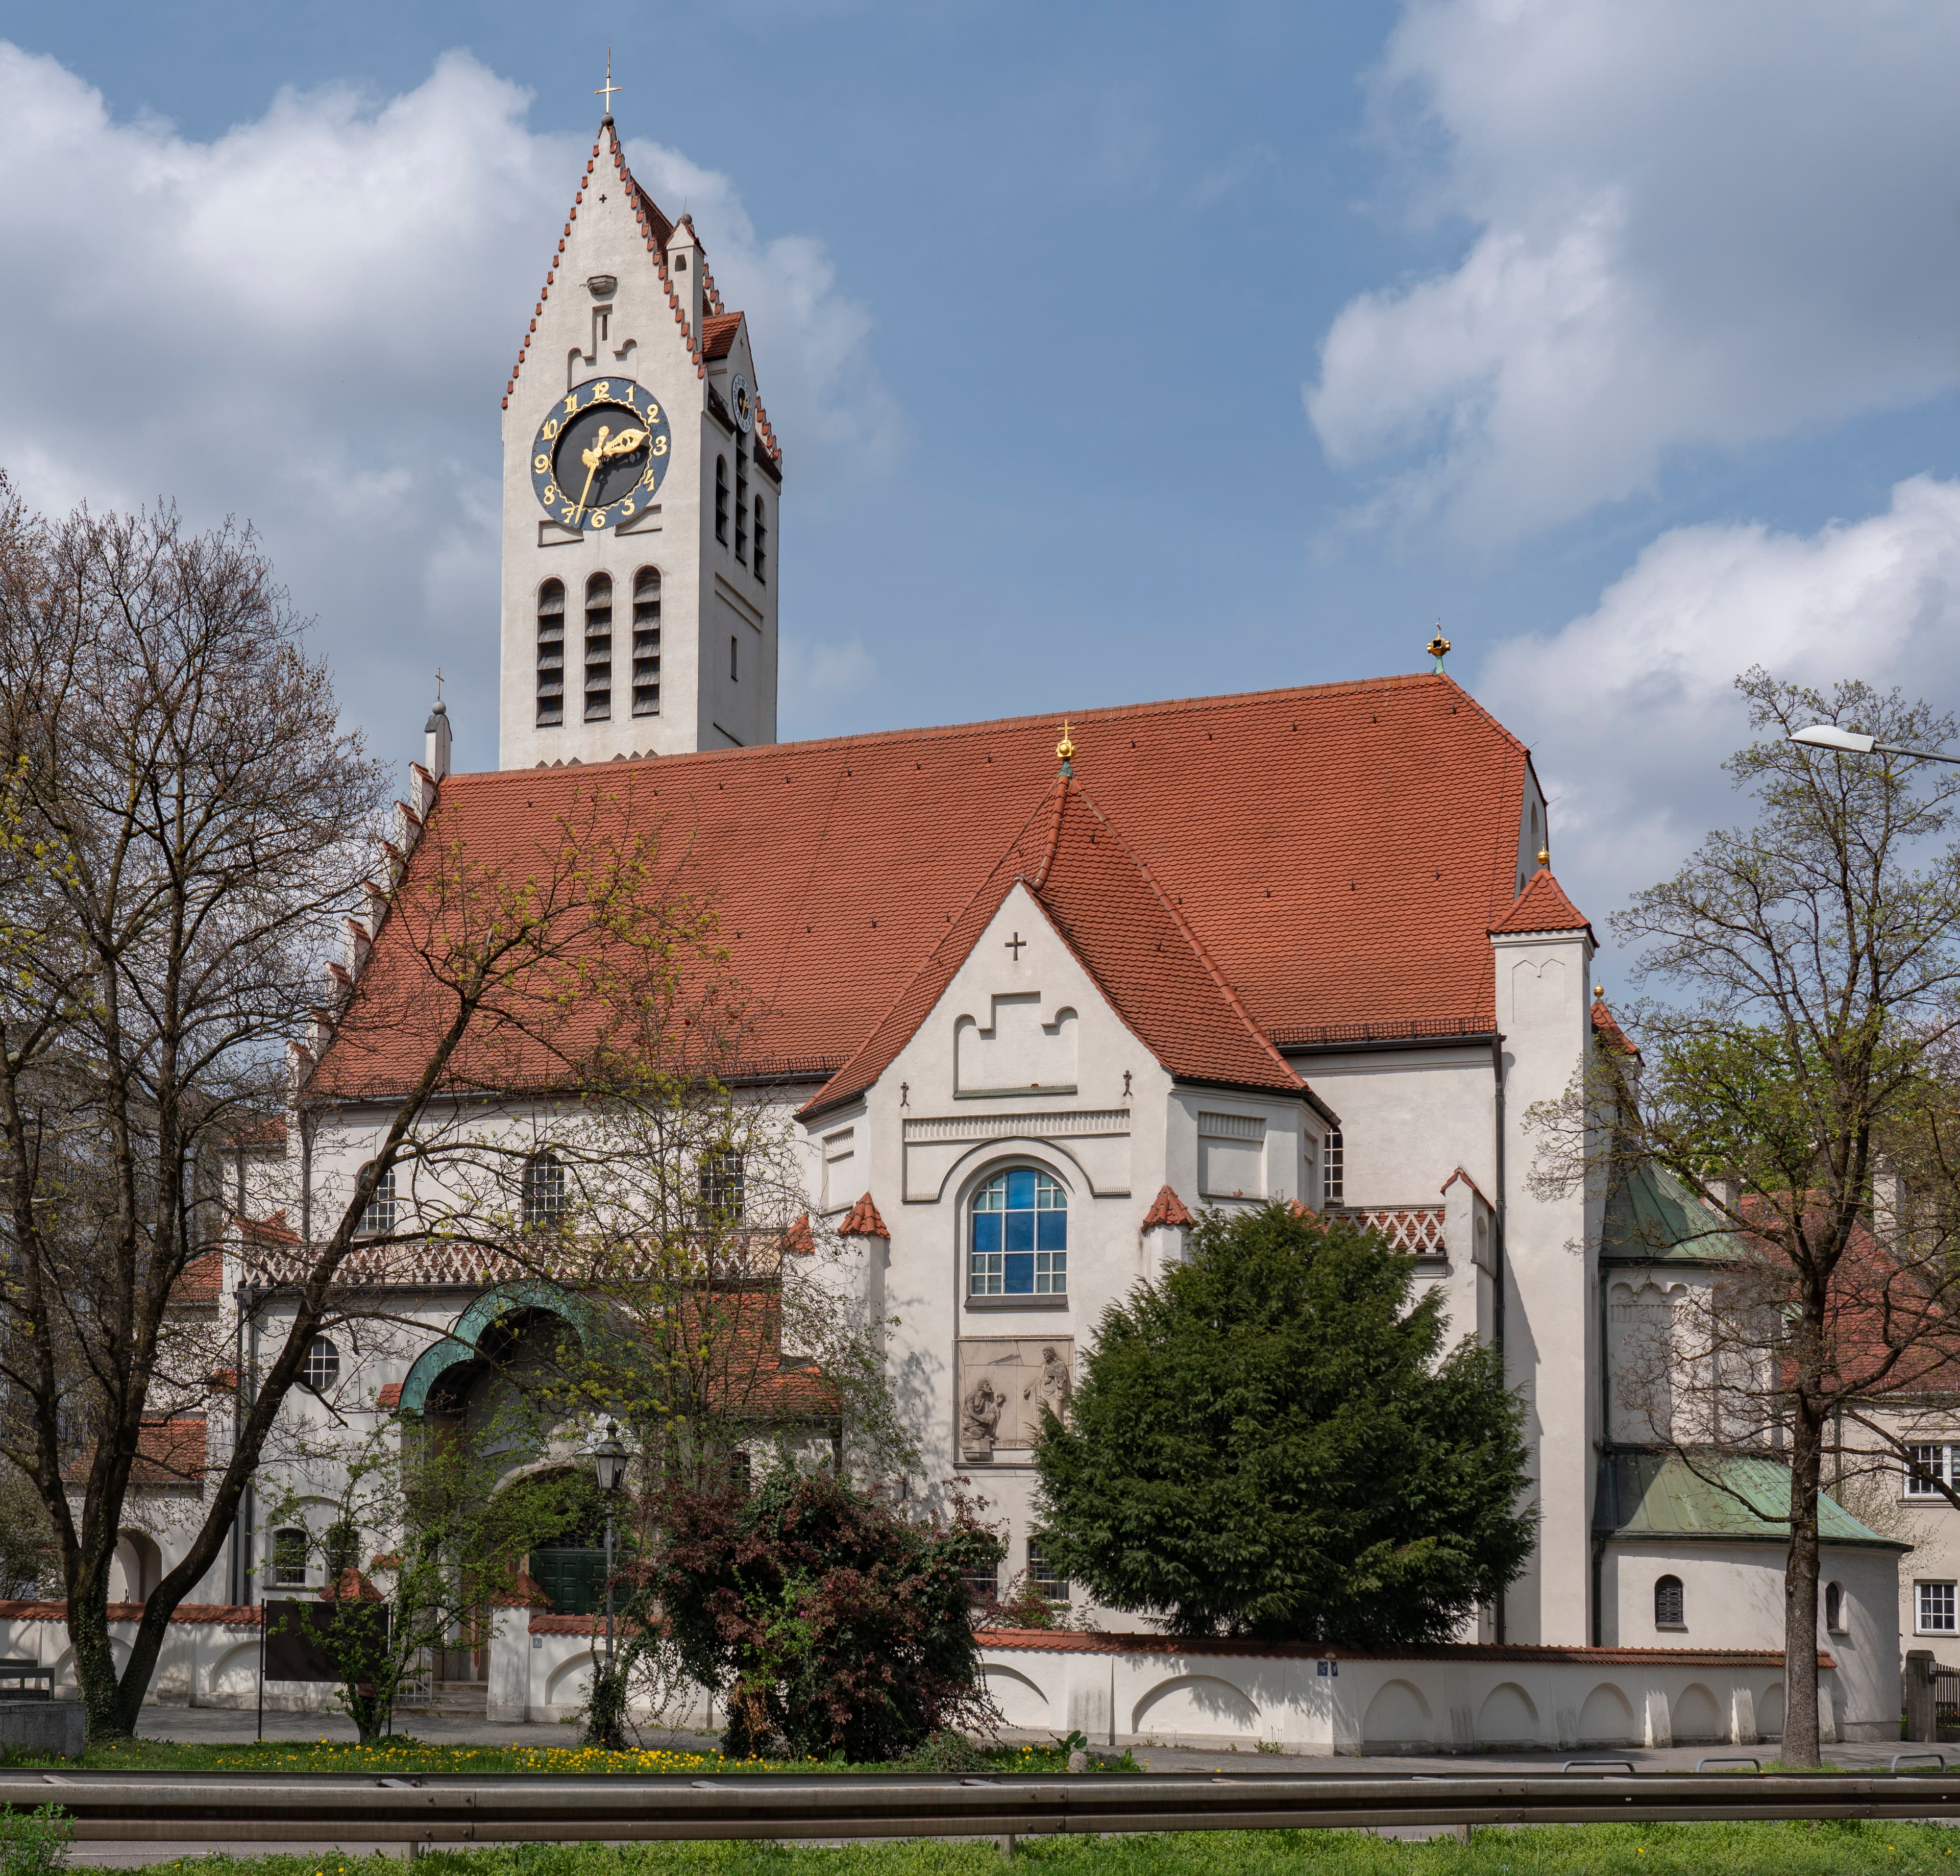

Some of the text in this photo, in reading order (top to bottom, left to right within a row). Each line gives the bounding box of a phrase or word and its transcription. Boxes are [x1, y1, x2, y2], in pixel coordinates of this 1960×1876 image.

[592, 381, 610, 400] 12
[625, 385, 634, 402] 1
[733, 389, 737, 399] 9
[564, 394, 578, 414] 11
[647, 404, 660, 424] 2
[542, 419, 557, 441] 10
[653, 435, 667, 456] 3
[534, 454, 549, 474] 9
[643, 470, 654, 491] 4
[543, 485, 555, 505] 8
[561, 507, 575, 523] 7
[621, 498, 635, 516] 5
[591, 510, 606, 528] 6
